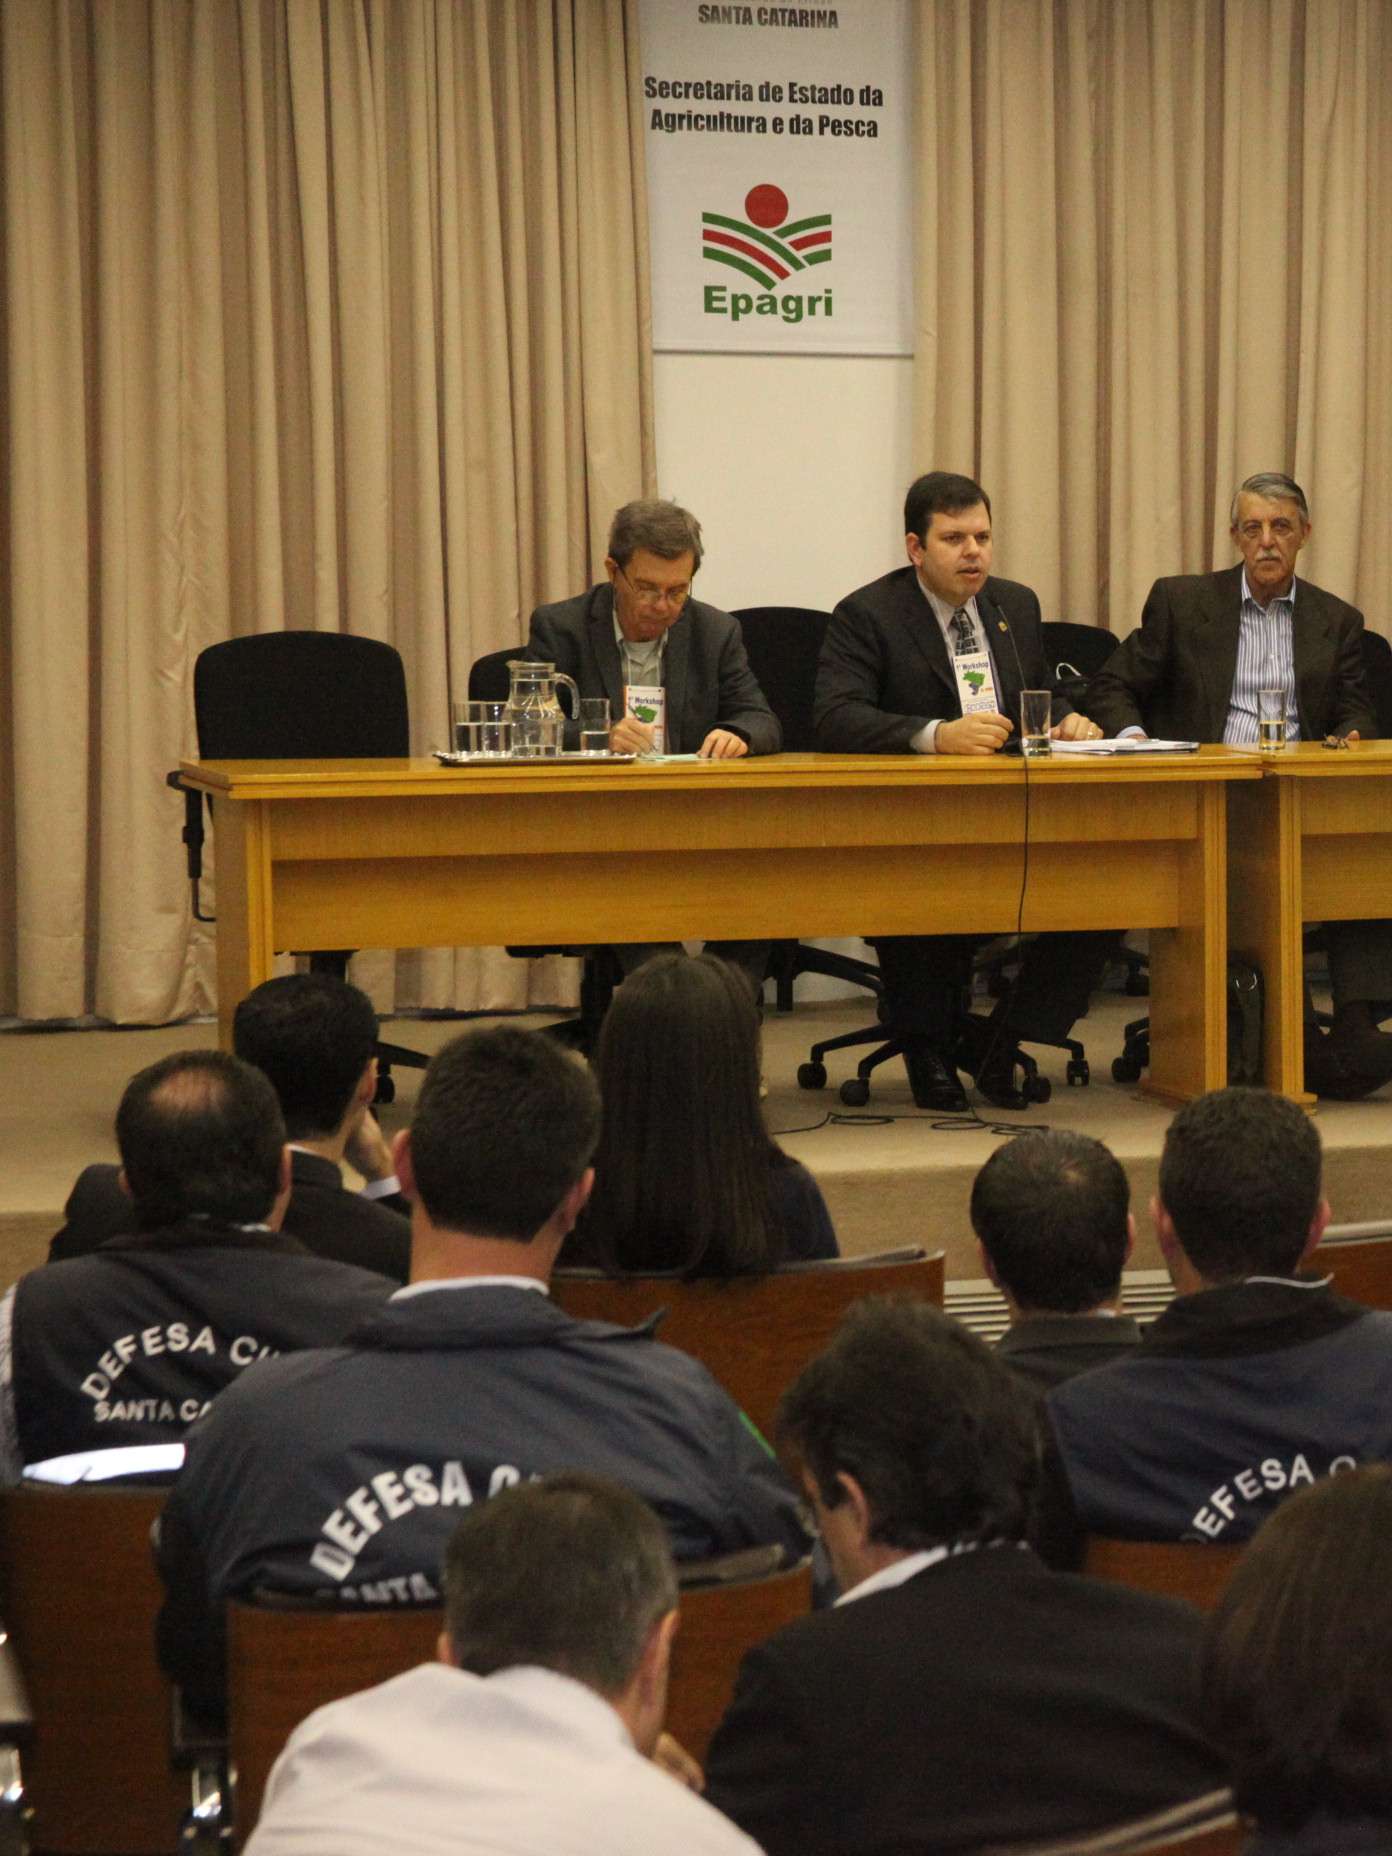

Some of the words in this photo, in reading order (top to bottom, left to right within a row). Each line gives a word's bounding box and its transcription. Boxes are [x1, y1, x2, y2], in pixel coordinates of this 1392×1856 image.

[698, 4, 754, 26] SANTA
[757, 7, 840, 29] CATARINA
[644, 76, 754, 102] Secretaria
[758, 81, 784, 103] de
[788, 82, 855, 106] Estado
[859, 85, 884, 107] da
[650, 108, 768, 134] Agricultura
[772, 116, 784, 134] e
[788, 114, 813, 136] da
[818, 115, 879, 138] Pesca
[703, 285, 833, 323] Epagri
[962, 661, 989, 671] Workshop
[634, 695, 664, 706] Workshop
[80, 1322, 217, 1401] DEFESA
[94, 1398, 175, 1423] SANTA
[309, 1460, 474, 1583] DEFESA
